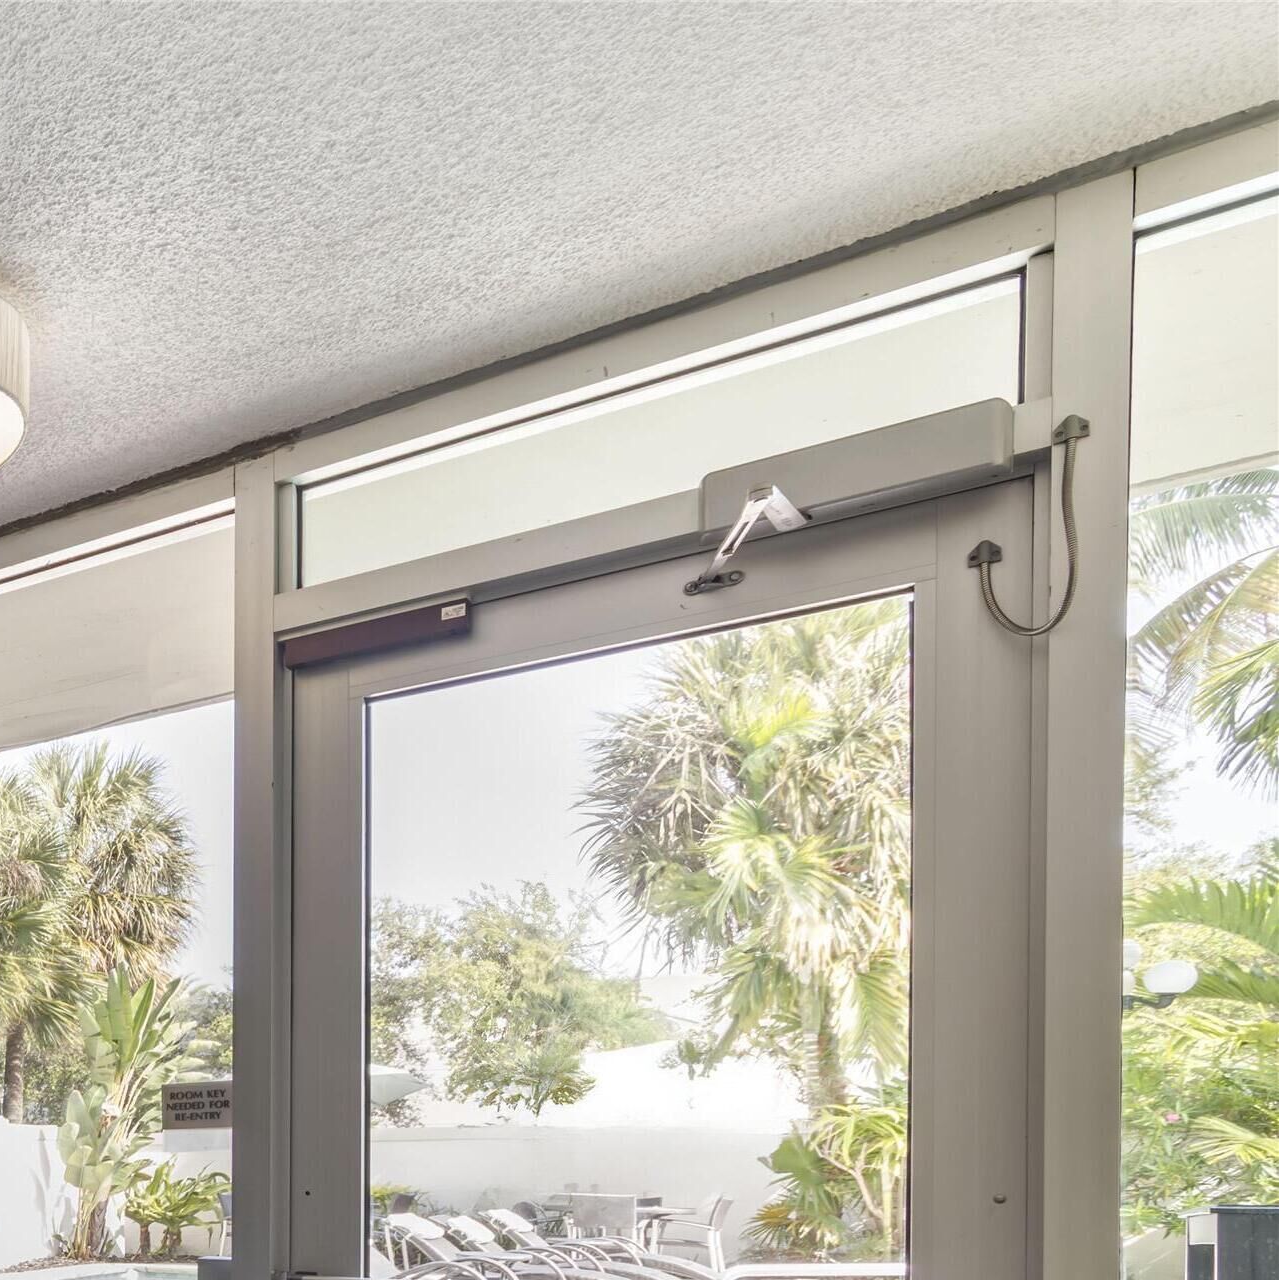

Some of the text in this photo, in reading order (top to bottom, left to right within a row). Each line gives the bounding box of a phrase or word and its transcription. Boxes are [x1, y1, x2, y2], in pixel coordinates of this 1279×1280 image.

[170, 1088, 227, 1101] ROOM KEY
[166, 1099, 230, 1111] NEEDED FOR
[175, 1111, 221, 1121] RE-ENTRY
